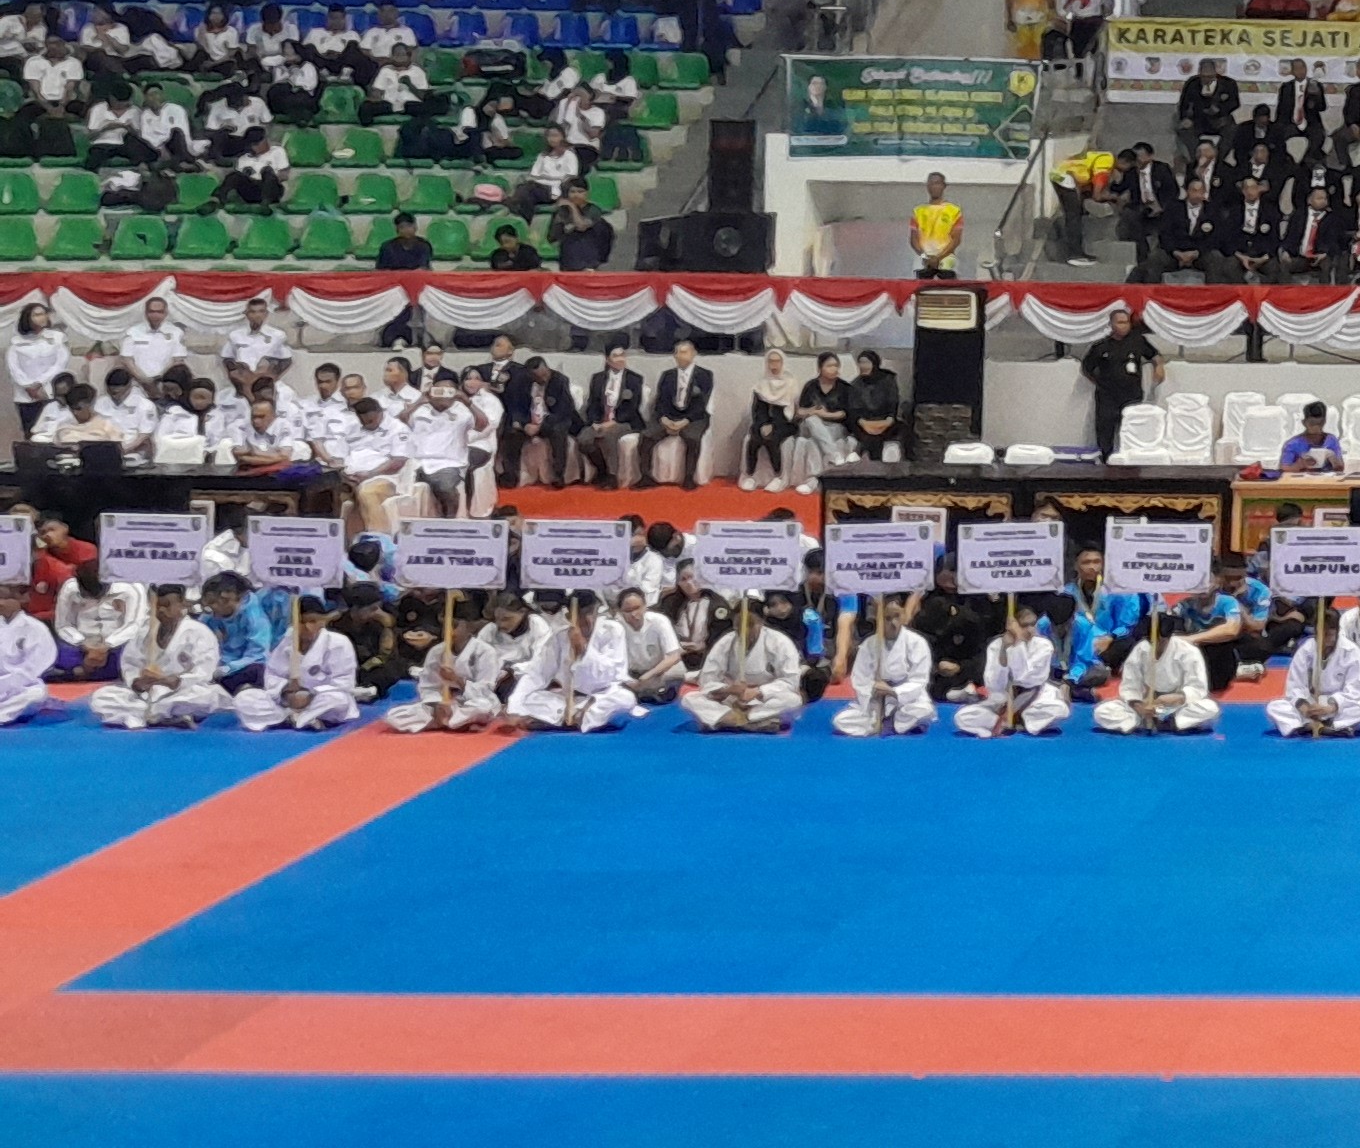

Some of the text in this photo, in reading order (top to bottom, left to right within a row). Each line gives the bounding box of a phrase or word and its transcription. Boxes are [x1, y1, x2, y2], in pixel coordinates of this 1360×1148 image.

[1117, 27, 1252, 47] KARATEKA
[1262, 29, 1349, 49] SEJATI
[1284, 563, 1360, 575] LAMPUNG
